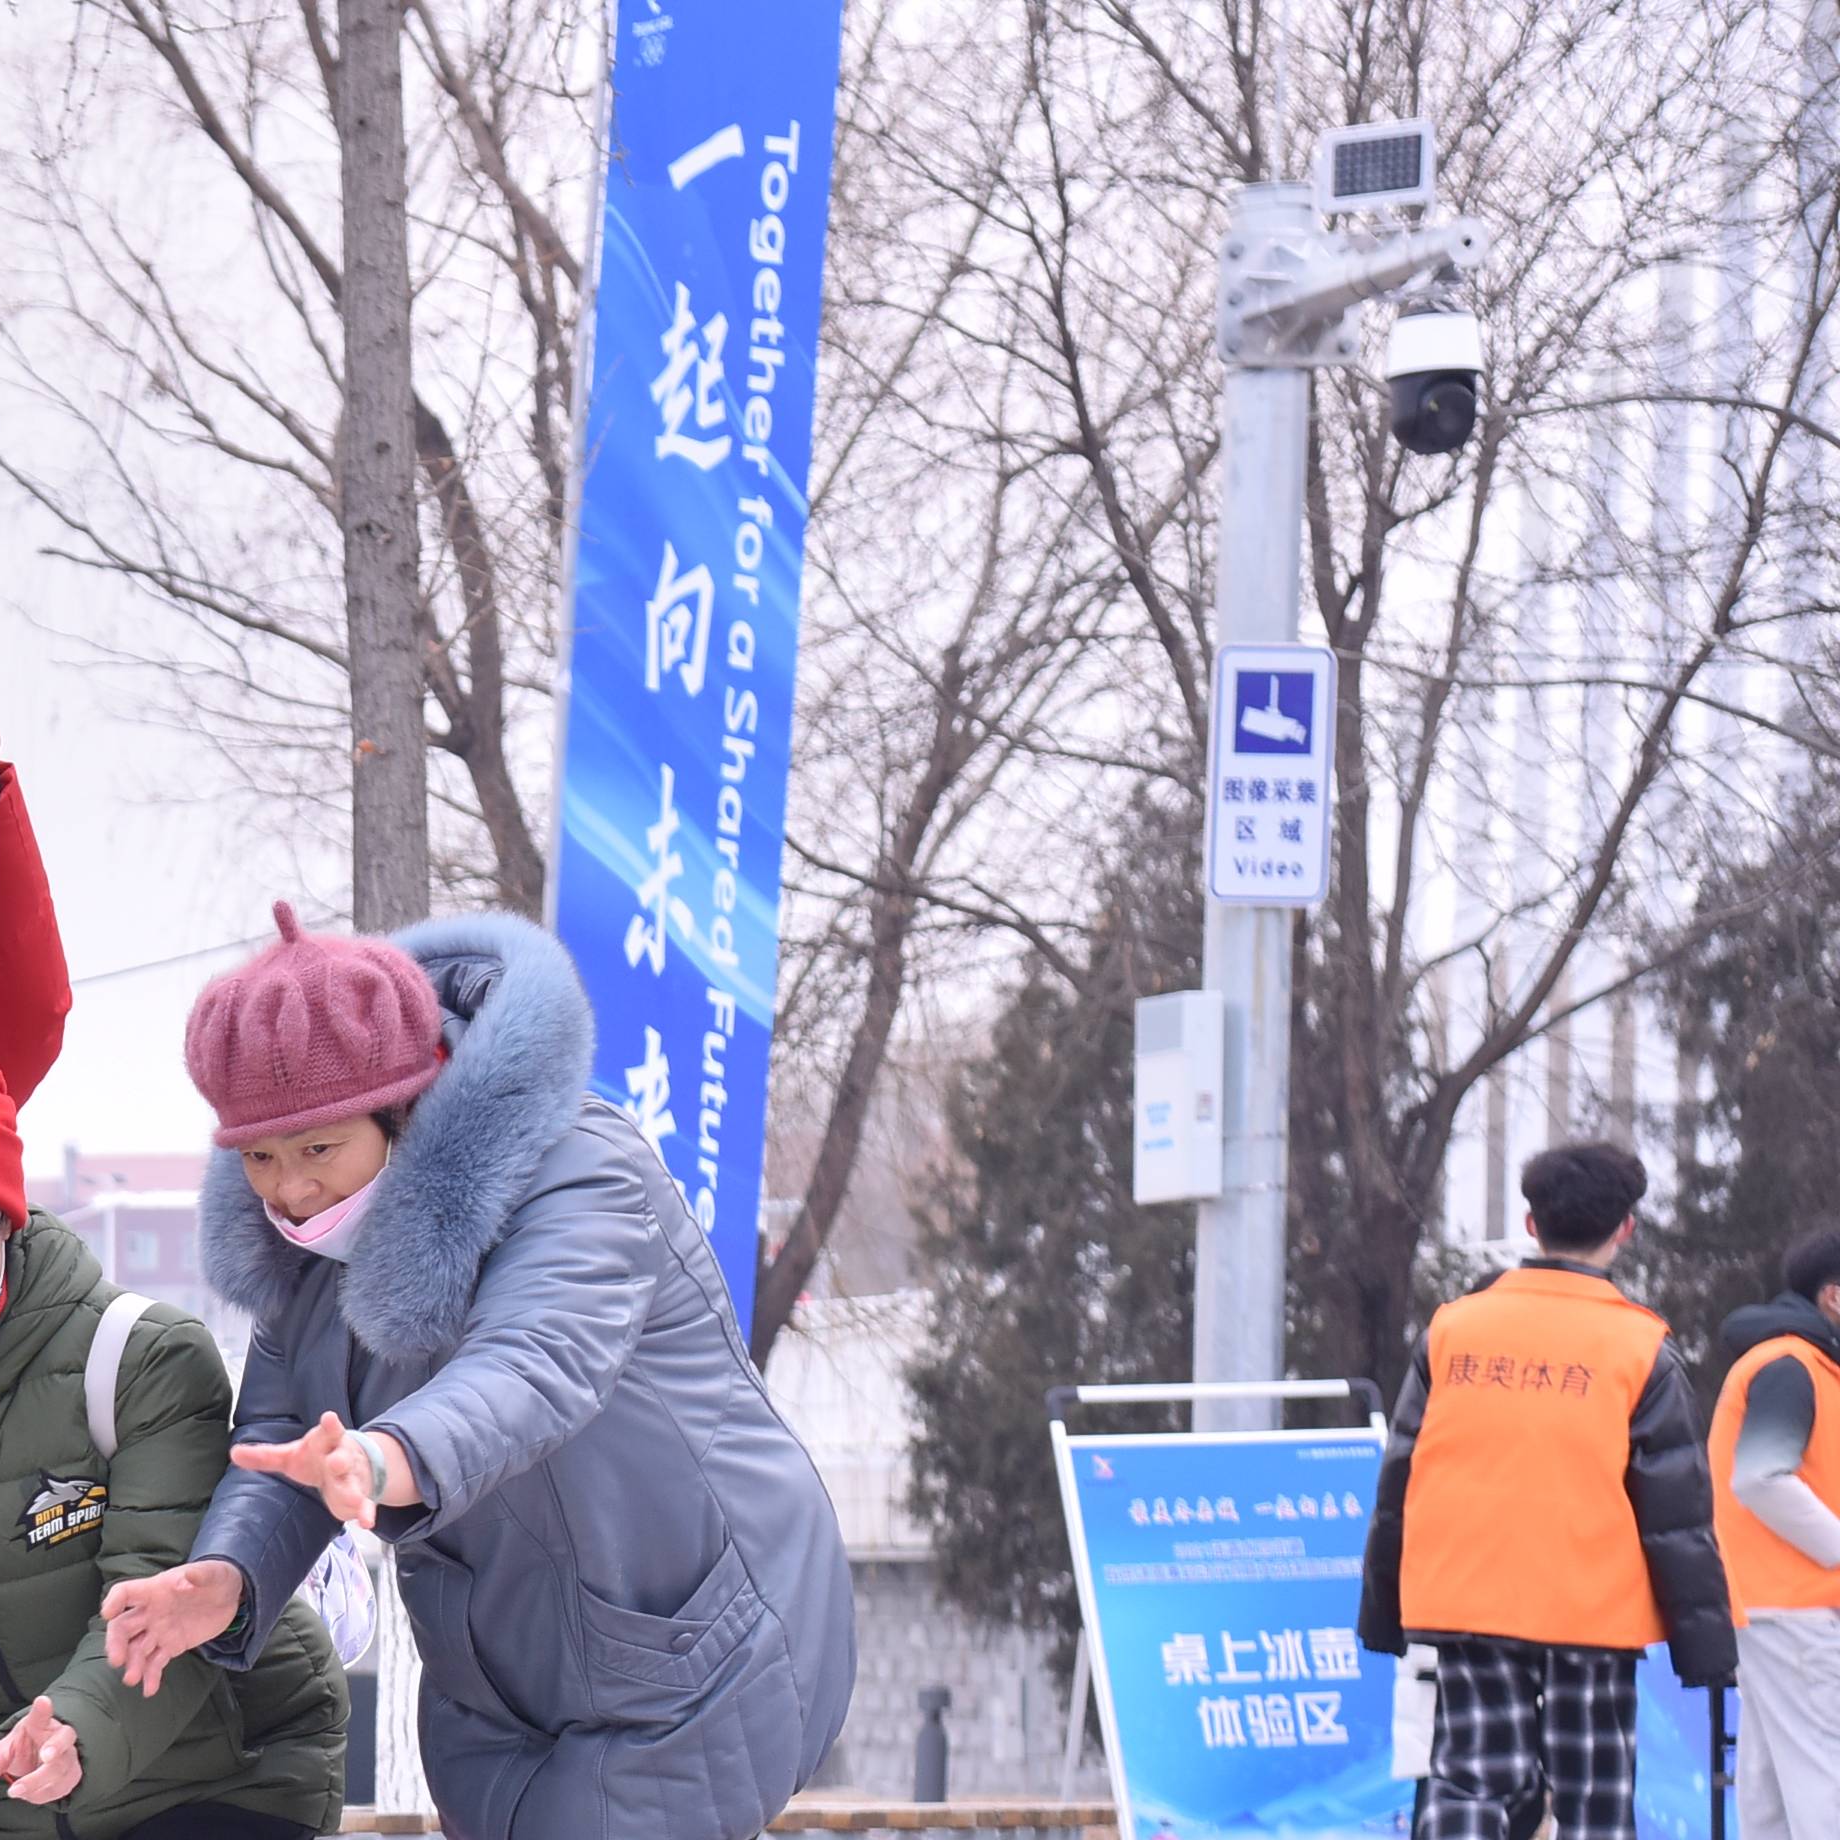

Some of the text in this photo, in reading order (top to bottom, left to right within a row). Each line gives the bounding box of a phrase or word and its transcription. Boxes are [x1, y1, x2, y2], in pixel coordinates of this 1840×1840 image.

[695, 119, 801, 1234] Together for a Shared Future
[1224, 776, 1317, 803] 图像采集
[1233, 856, 1305, 878] Video
[1445, 1352, 1594, 1399] 康奥体育
[27, 1517, 64, 1544] TEAM
[67, 1501, 107, 1527] SPIRIT
[1161, 1627, 1362, 1686] 桌上冰壶
[1198, 1690, 1350, 1749] 体验区
